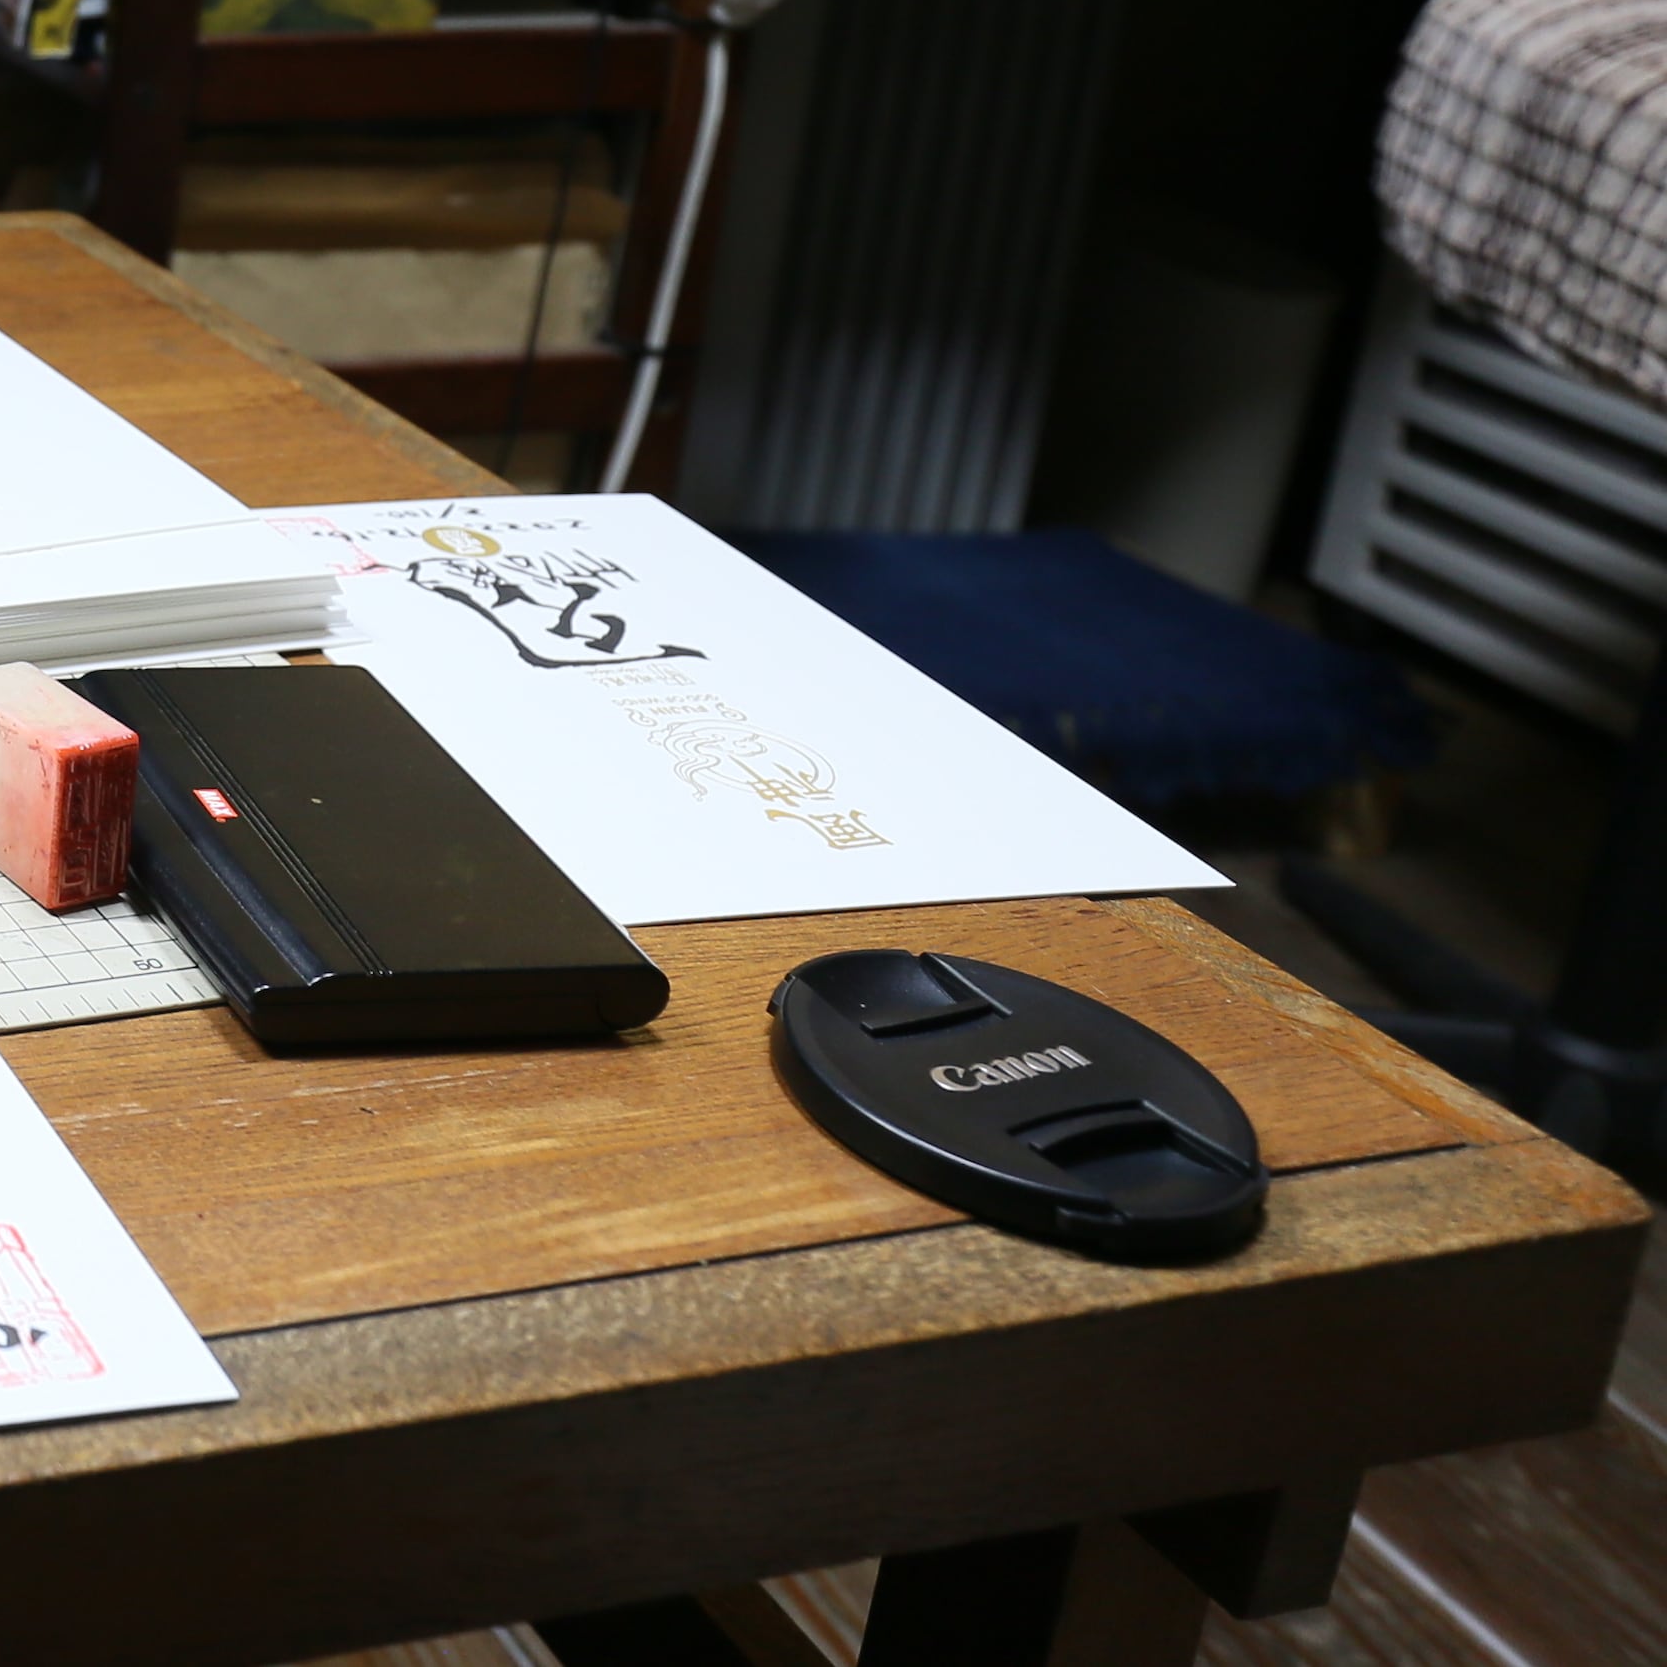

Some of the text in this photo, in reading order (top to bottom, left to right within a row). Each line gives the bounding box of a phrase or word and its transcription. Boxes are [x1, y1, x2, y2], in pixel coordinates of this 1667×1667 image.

[198, 790, 234, 816] MAX
[133, 958, 163, 971] 50
[929, 1044, 1093, 1093] Canon
